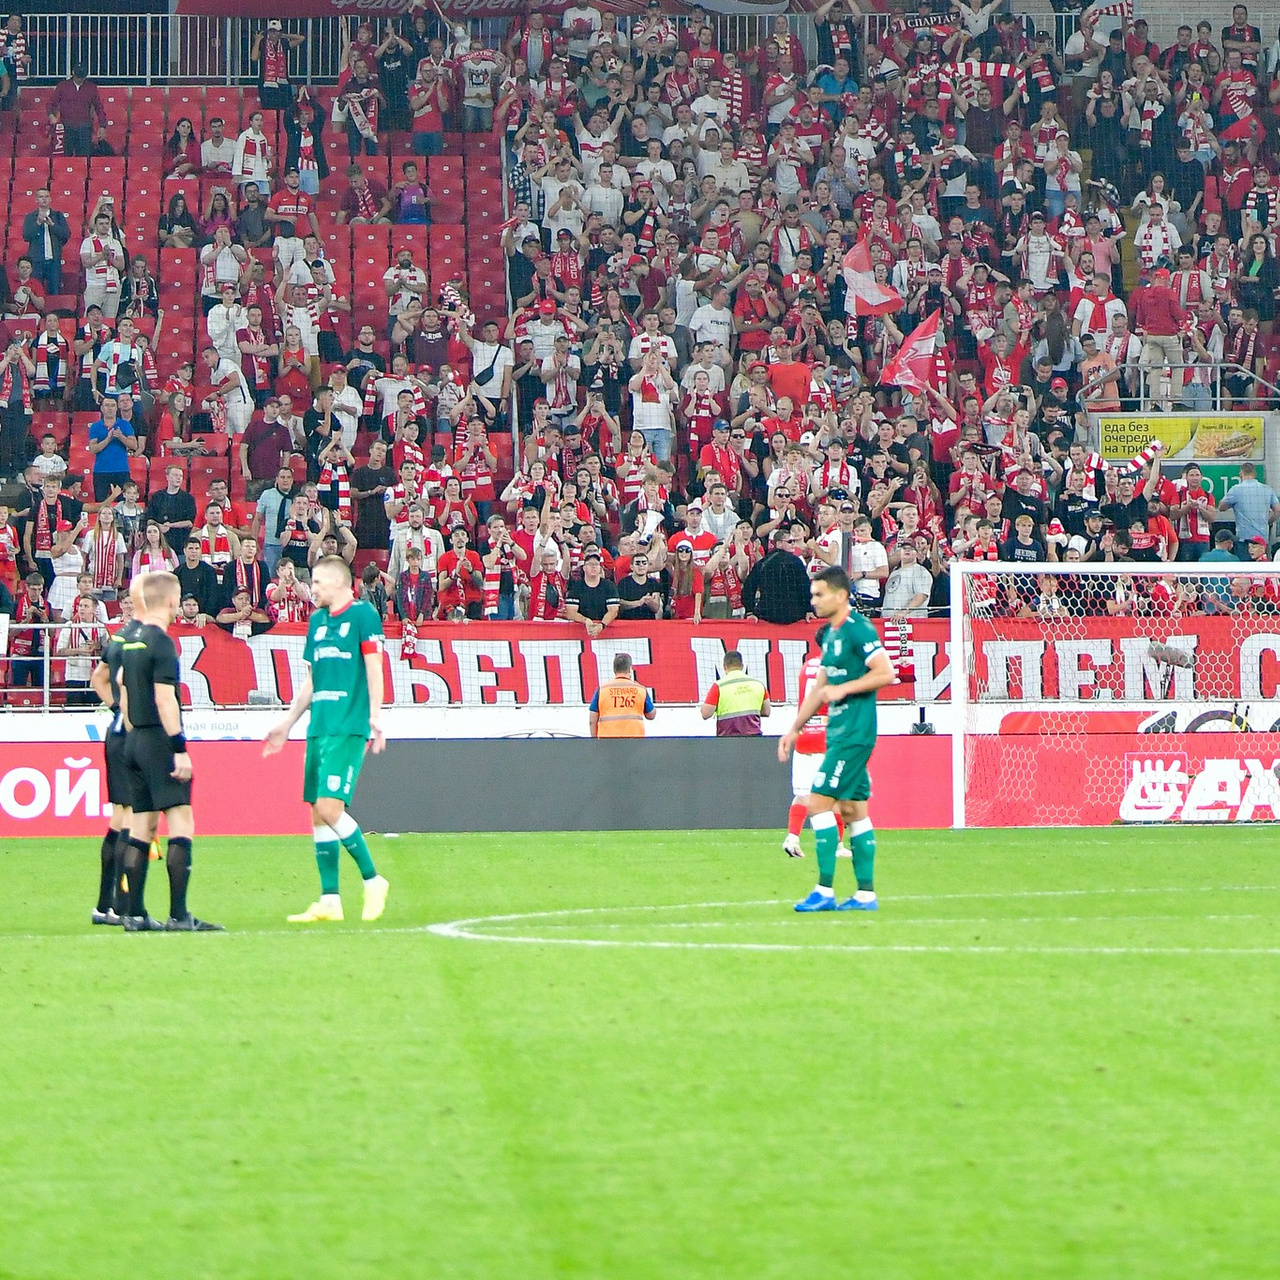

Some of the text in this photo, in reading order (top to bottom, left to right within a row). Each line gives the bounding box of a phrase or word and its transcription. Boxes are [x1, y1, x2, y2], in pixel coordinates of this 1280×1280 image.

[1104, 421, 1149, 433] еда без
[1104, 434, 1156, 444] очереди
[1104, 444, 1118, 453] на
[609, 687, 638, 696] STEWARD
[611, 695, 636, 708] T265
[211, 722, 239, 732] вода
